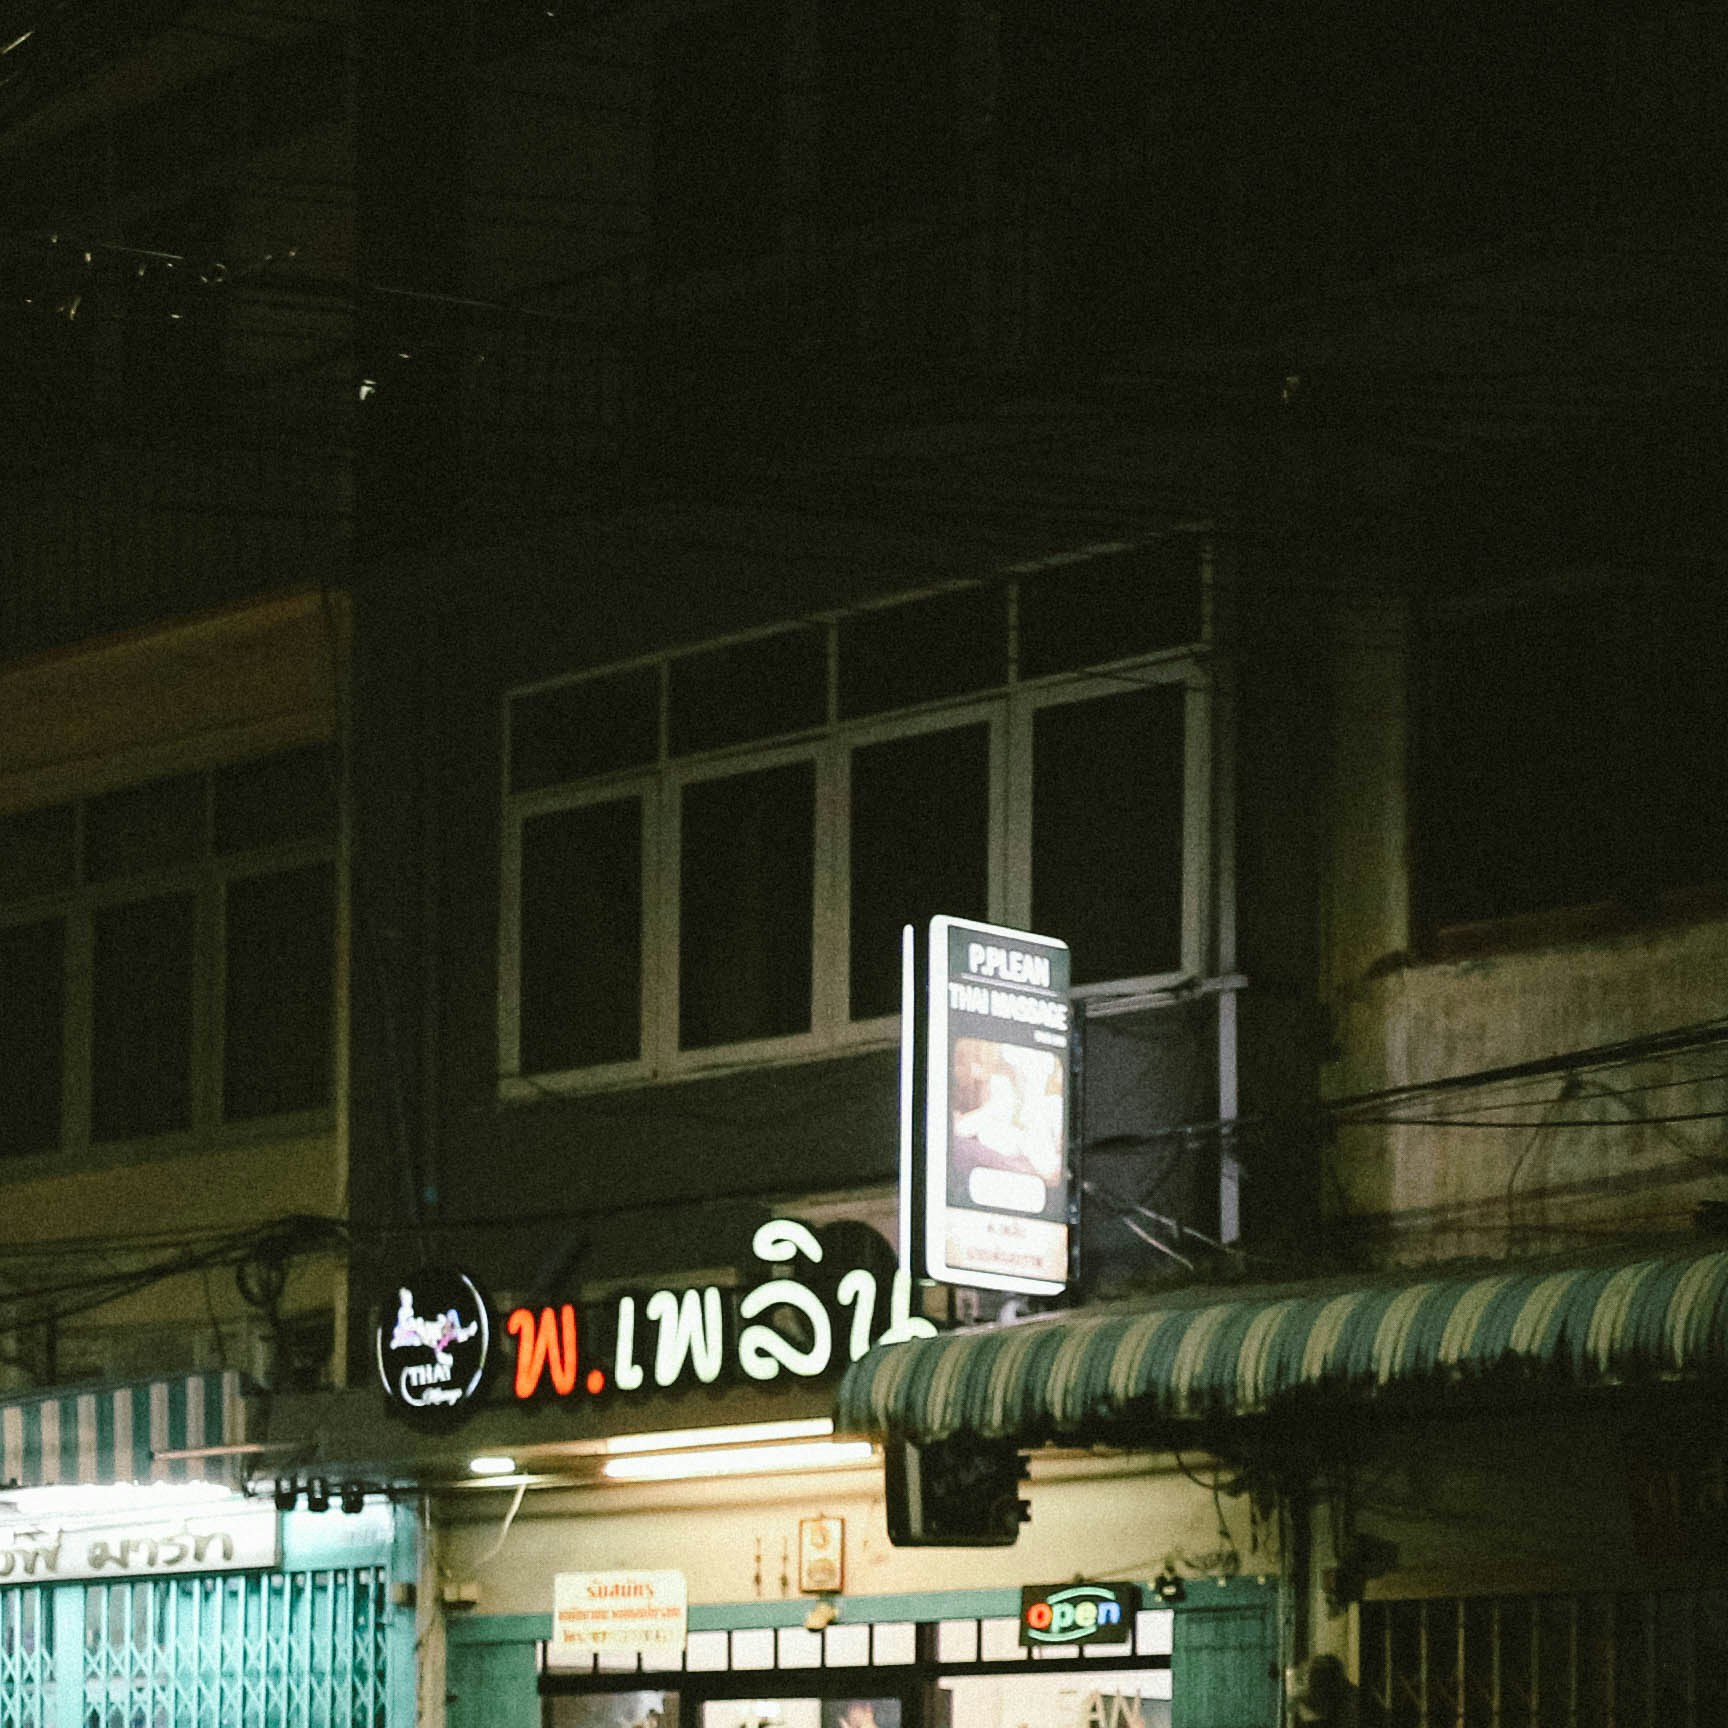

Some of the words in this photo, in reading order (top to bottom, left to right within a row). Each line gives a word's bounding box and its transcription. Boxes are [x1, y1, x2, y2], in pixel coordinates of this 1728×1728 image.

[968, 942, 1051, 988] P.PLEAN
[948, 982, 990, 1015] THAI
[990, 990, 1069, 1031] MASSAGE
[1026, 1600, 1122, 1634] open
